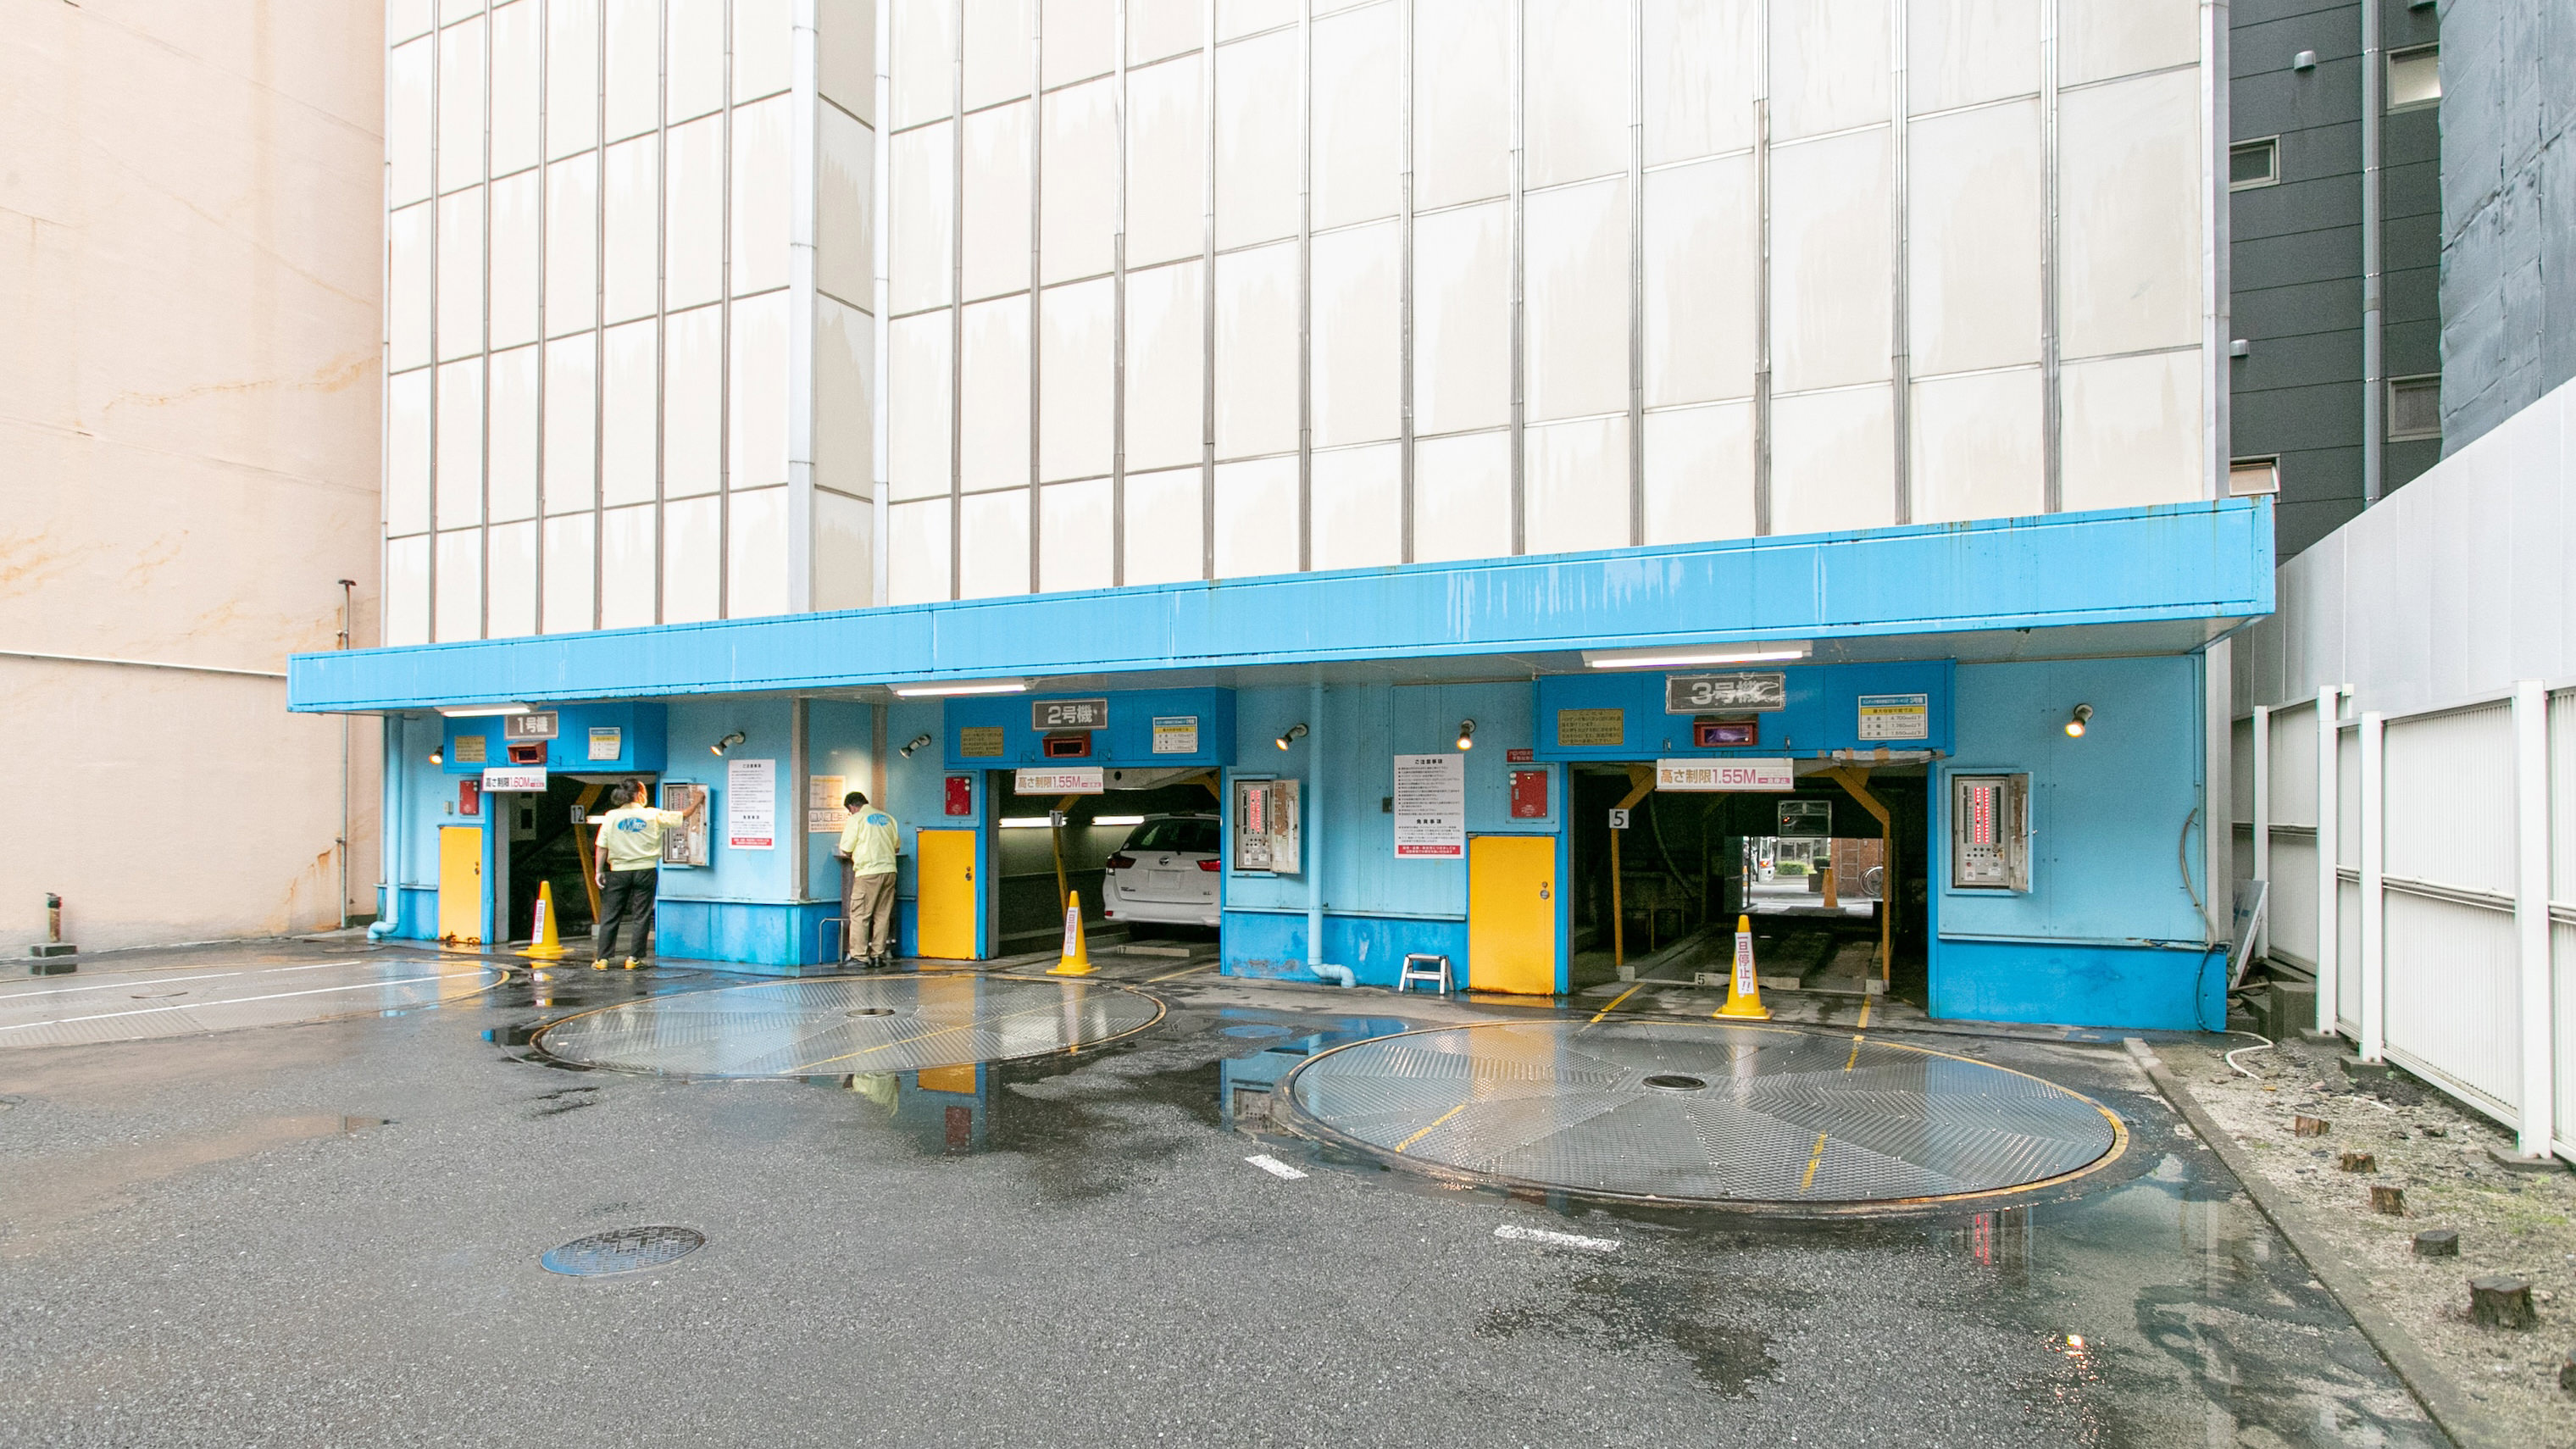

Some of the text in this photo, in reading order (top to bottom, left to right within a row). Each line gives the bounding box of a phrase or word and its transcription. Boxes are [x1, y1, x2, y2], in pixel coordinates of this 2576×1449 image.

[1691, 680, 1760, 704] 3号機
[1047, 705, 1092, 724] 2号機
[518, 716, 547, 734] 1号機
[1018, 776, 1080, 788] 高さ制限1.55M
[1661, 769, 1756, 784] 高さ制限1.55M
[573, 807, 584, 822] 12
[1052, 813, 1062, 825] 17
[1613, 811, 1624, 826] 5
[1737, 936, 1751, 991] 一旦停止!!
[1697, 974, 1705, 985] 5
